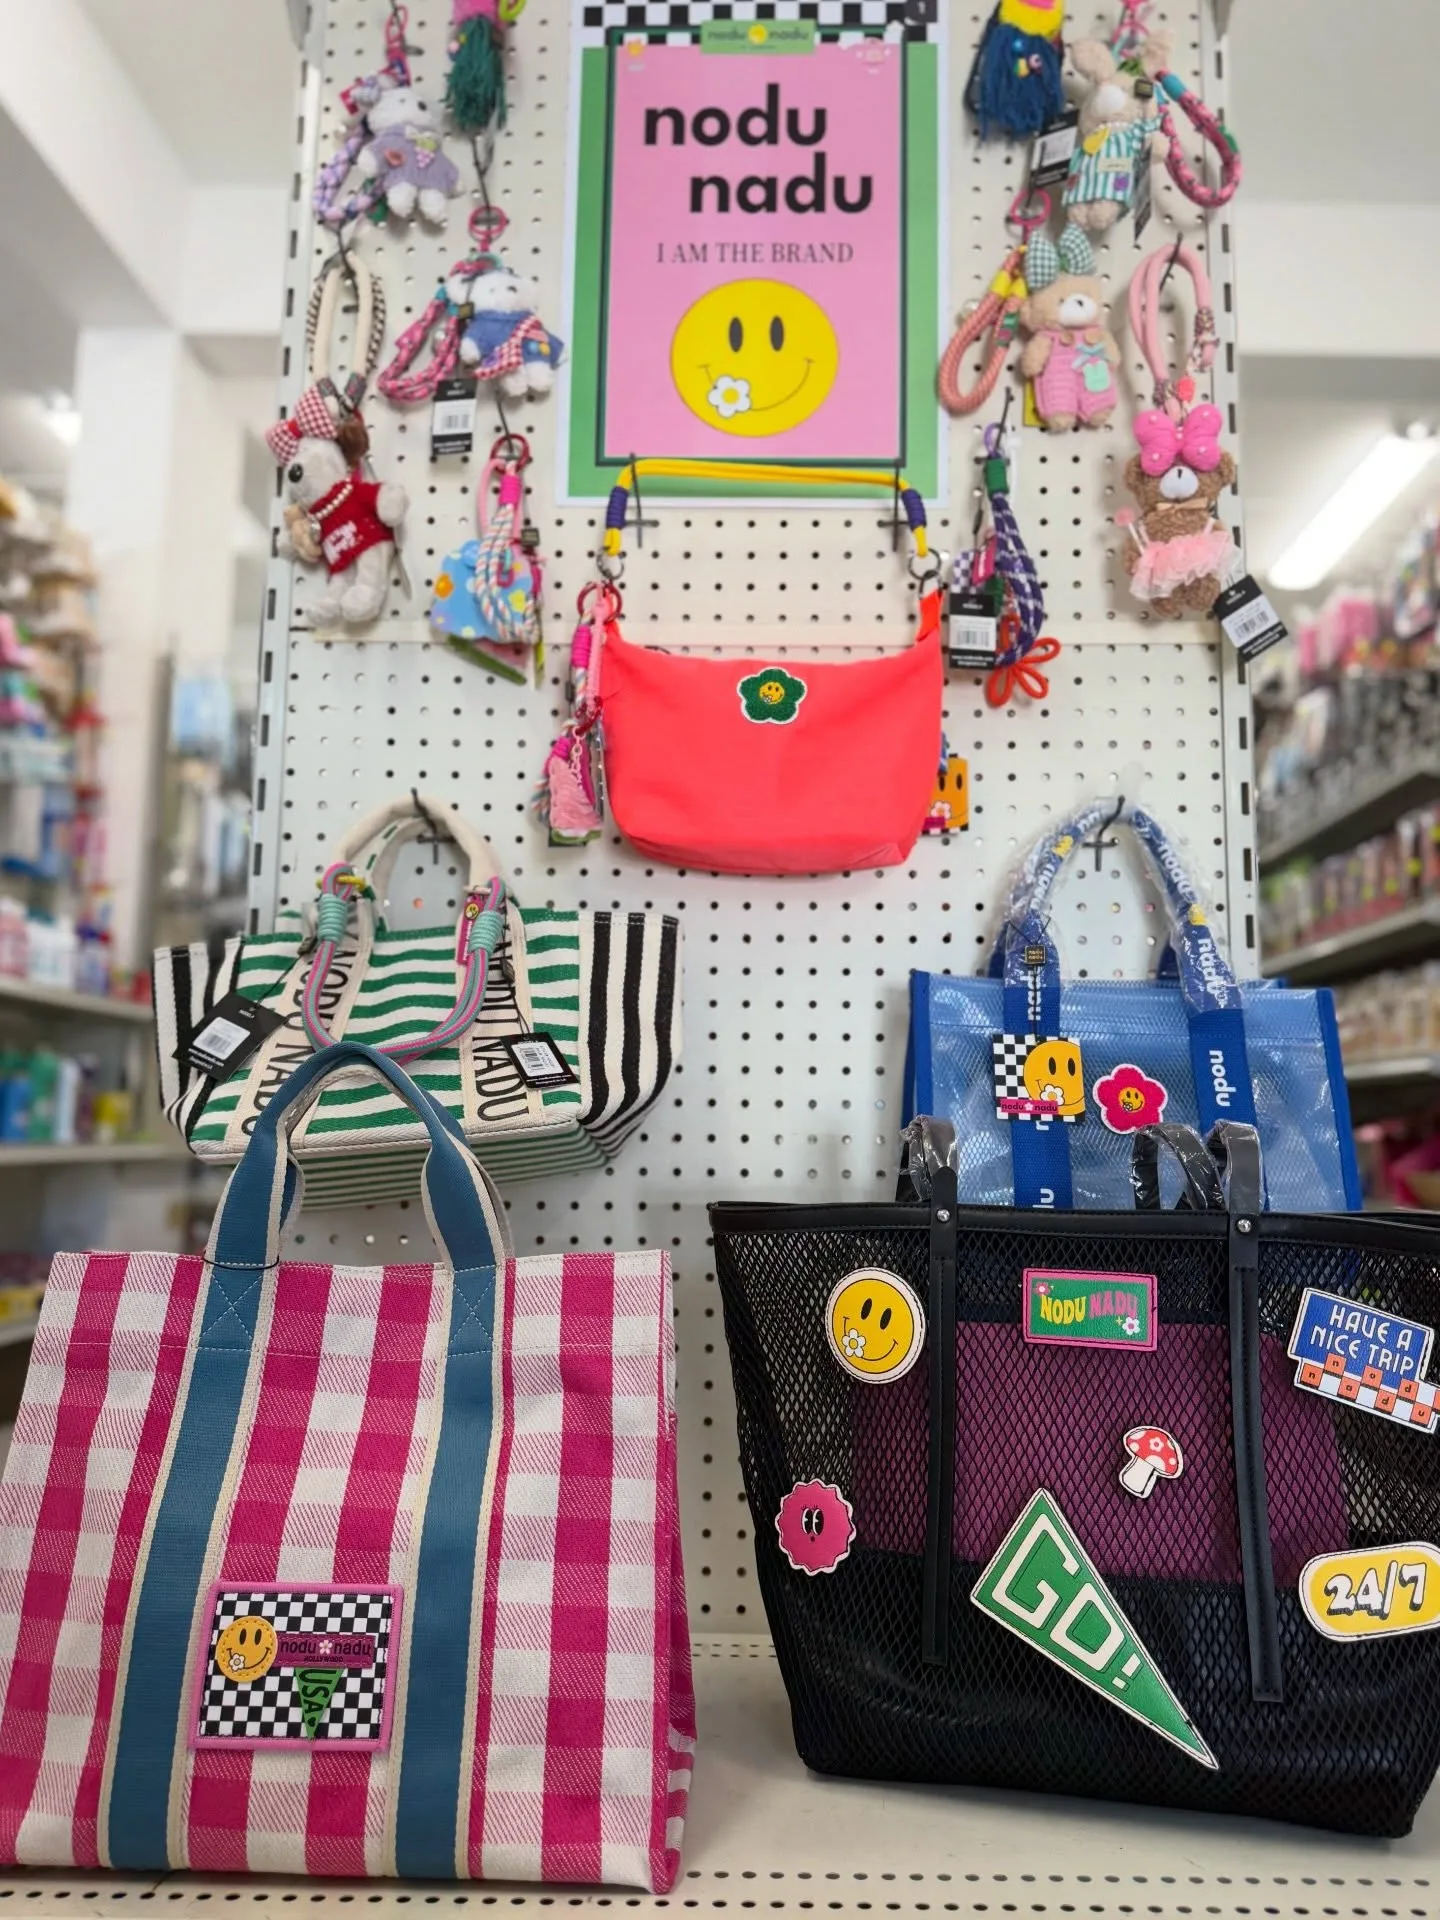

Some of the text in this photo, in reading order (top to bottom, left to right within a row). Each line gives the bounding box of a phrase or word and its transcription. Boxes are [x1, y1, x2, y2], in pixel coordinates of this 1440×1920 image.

[644, 83, 827, 146] nodu
[690, 151, 873, 214] nadu
[657, 243, 854, 263] I AM THE BRAND
[471, 1036, 530, 1122] NADU
[1209, 1050, 1237, 1107] nodu
[1001, 1102, 1058, 1112] nodu nadu
[1040, 1290, 1139, 1325] NODU NADU
[1329, 1304, 1413, 1351] HAVE A
[1310, 1325, 1414, 1375] NICE TRIP
[992, 1513, 1143, 1690] GO!
[1325, 1560, 1428, 1619] 24/7
[280, 1640, 371, 1656] nodu nadu
[298, 1669, 338, 1715] USA
